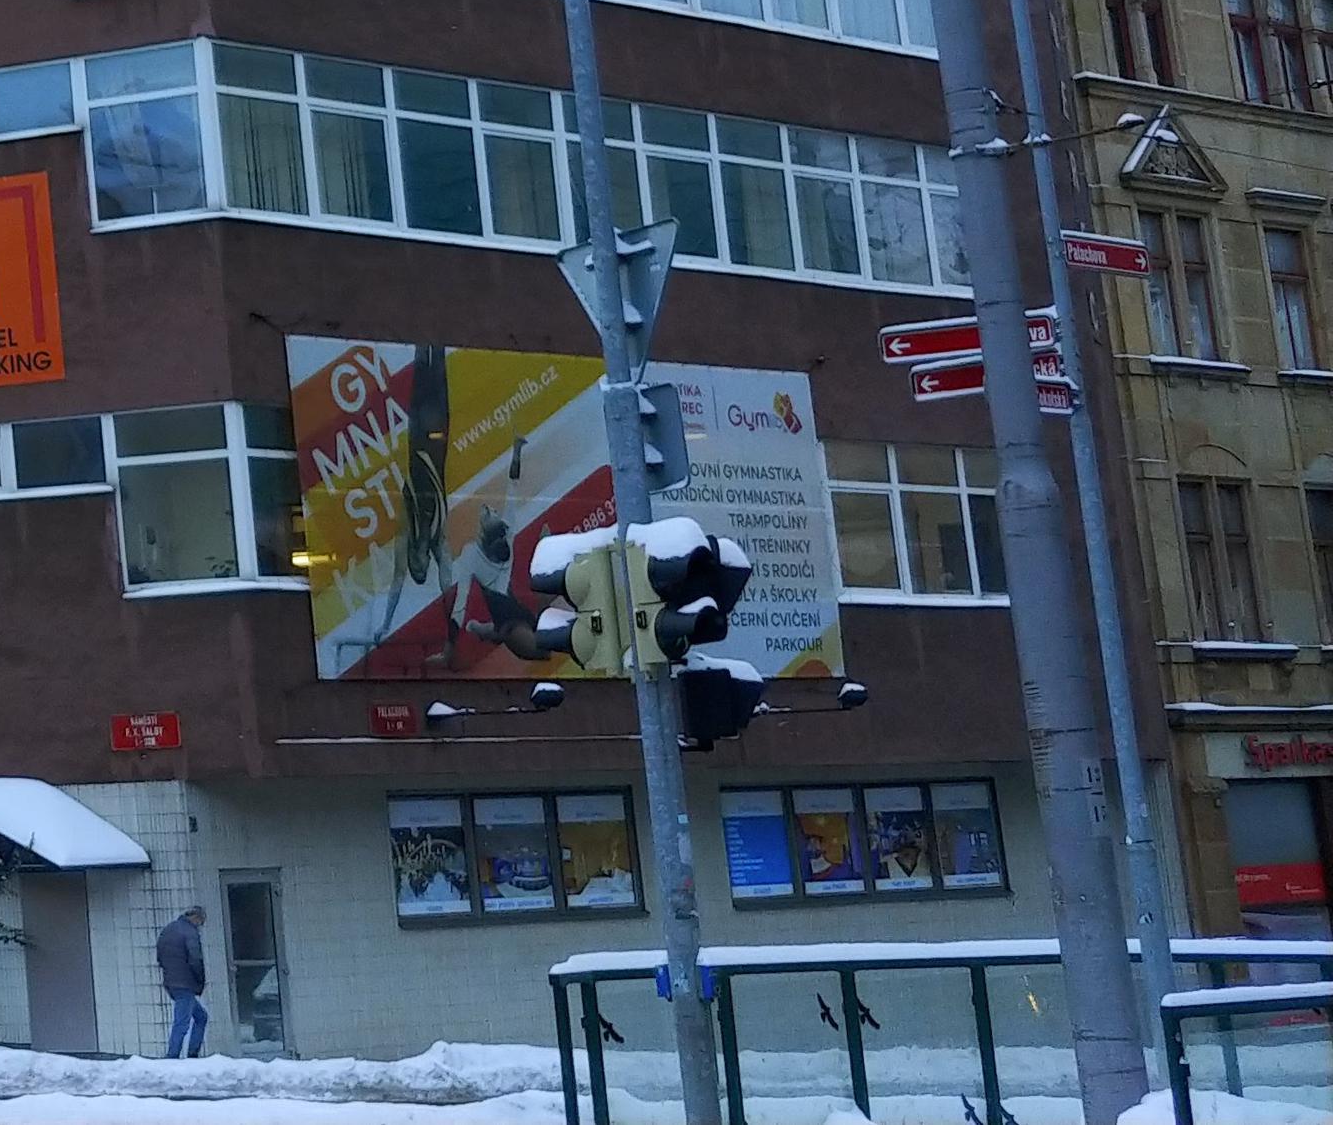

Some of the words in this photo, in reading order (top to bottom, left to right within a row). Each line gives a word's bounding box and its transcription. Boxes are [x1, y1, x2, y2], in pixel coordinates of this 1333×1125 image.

[1067, 243, 1107, 265] Palachova
[453, 366, 559, 454] www.gymlib.cz
[723, 463, 802, 481] GYMNASTIKA
[726, 489, 805, 506] GYMNASTIKA
[729, 511, 808, 529] TRAMPOLÍNY
[752, 537, 811, 553] TRÉNINKY
[773, 562, 815, 578] RODIČI
[760, 588, 768, 601] A
[771, 584, 817, 602] ŠKOLKY
[771, 611, 821, 627] CVIČENÍ
[766, 637, 823, 652] PARKOUR
